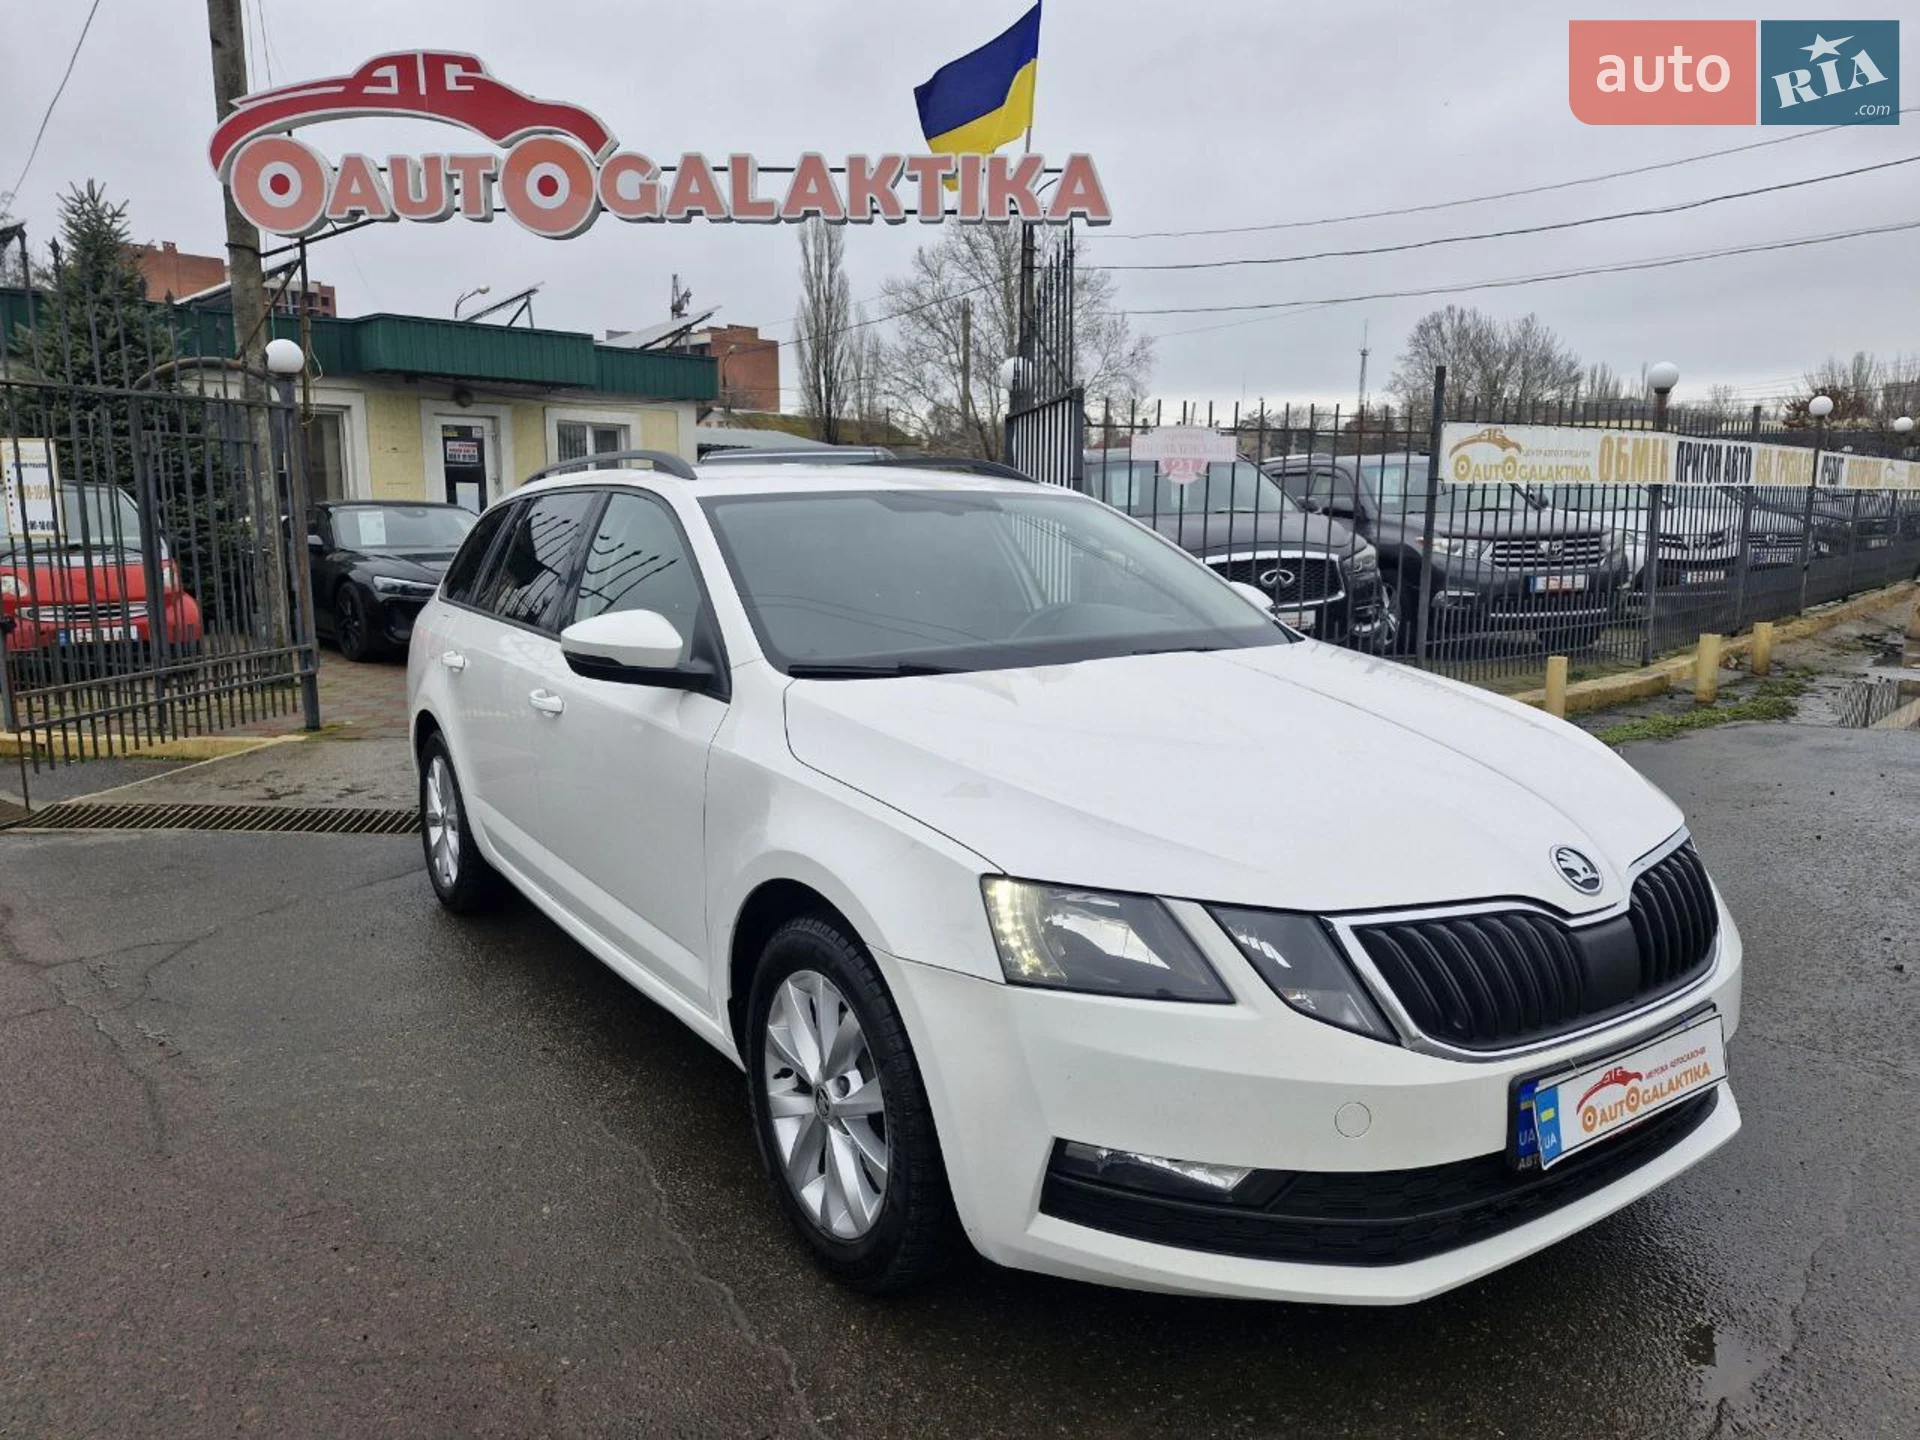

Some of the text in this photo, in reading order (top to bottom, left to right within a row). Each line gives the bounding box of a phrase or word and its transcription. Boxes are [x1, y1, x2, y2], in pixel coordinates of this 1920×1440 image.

[1675, 440, 1723, 484] ПРИГОН
[1519, 1127, 1536, 1146] UA
[1544, 1132, 1558, 1150] UA
